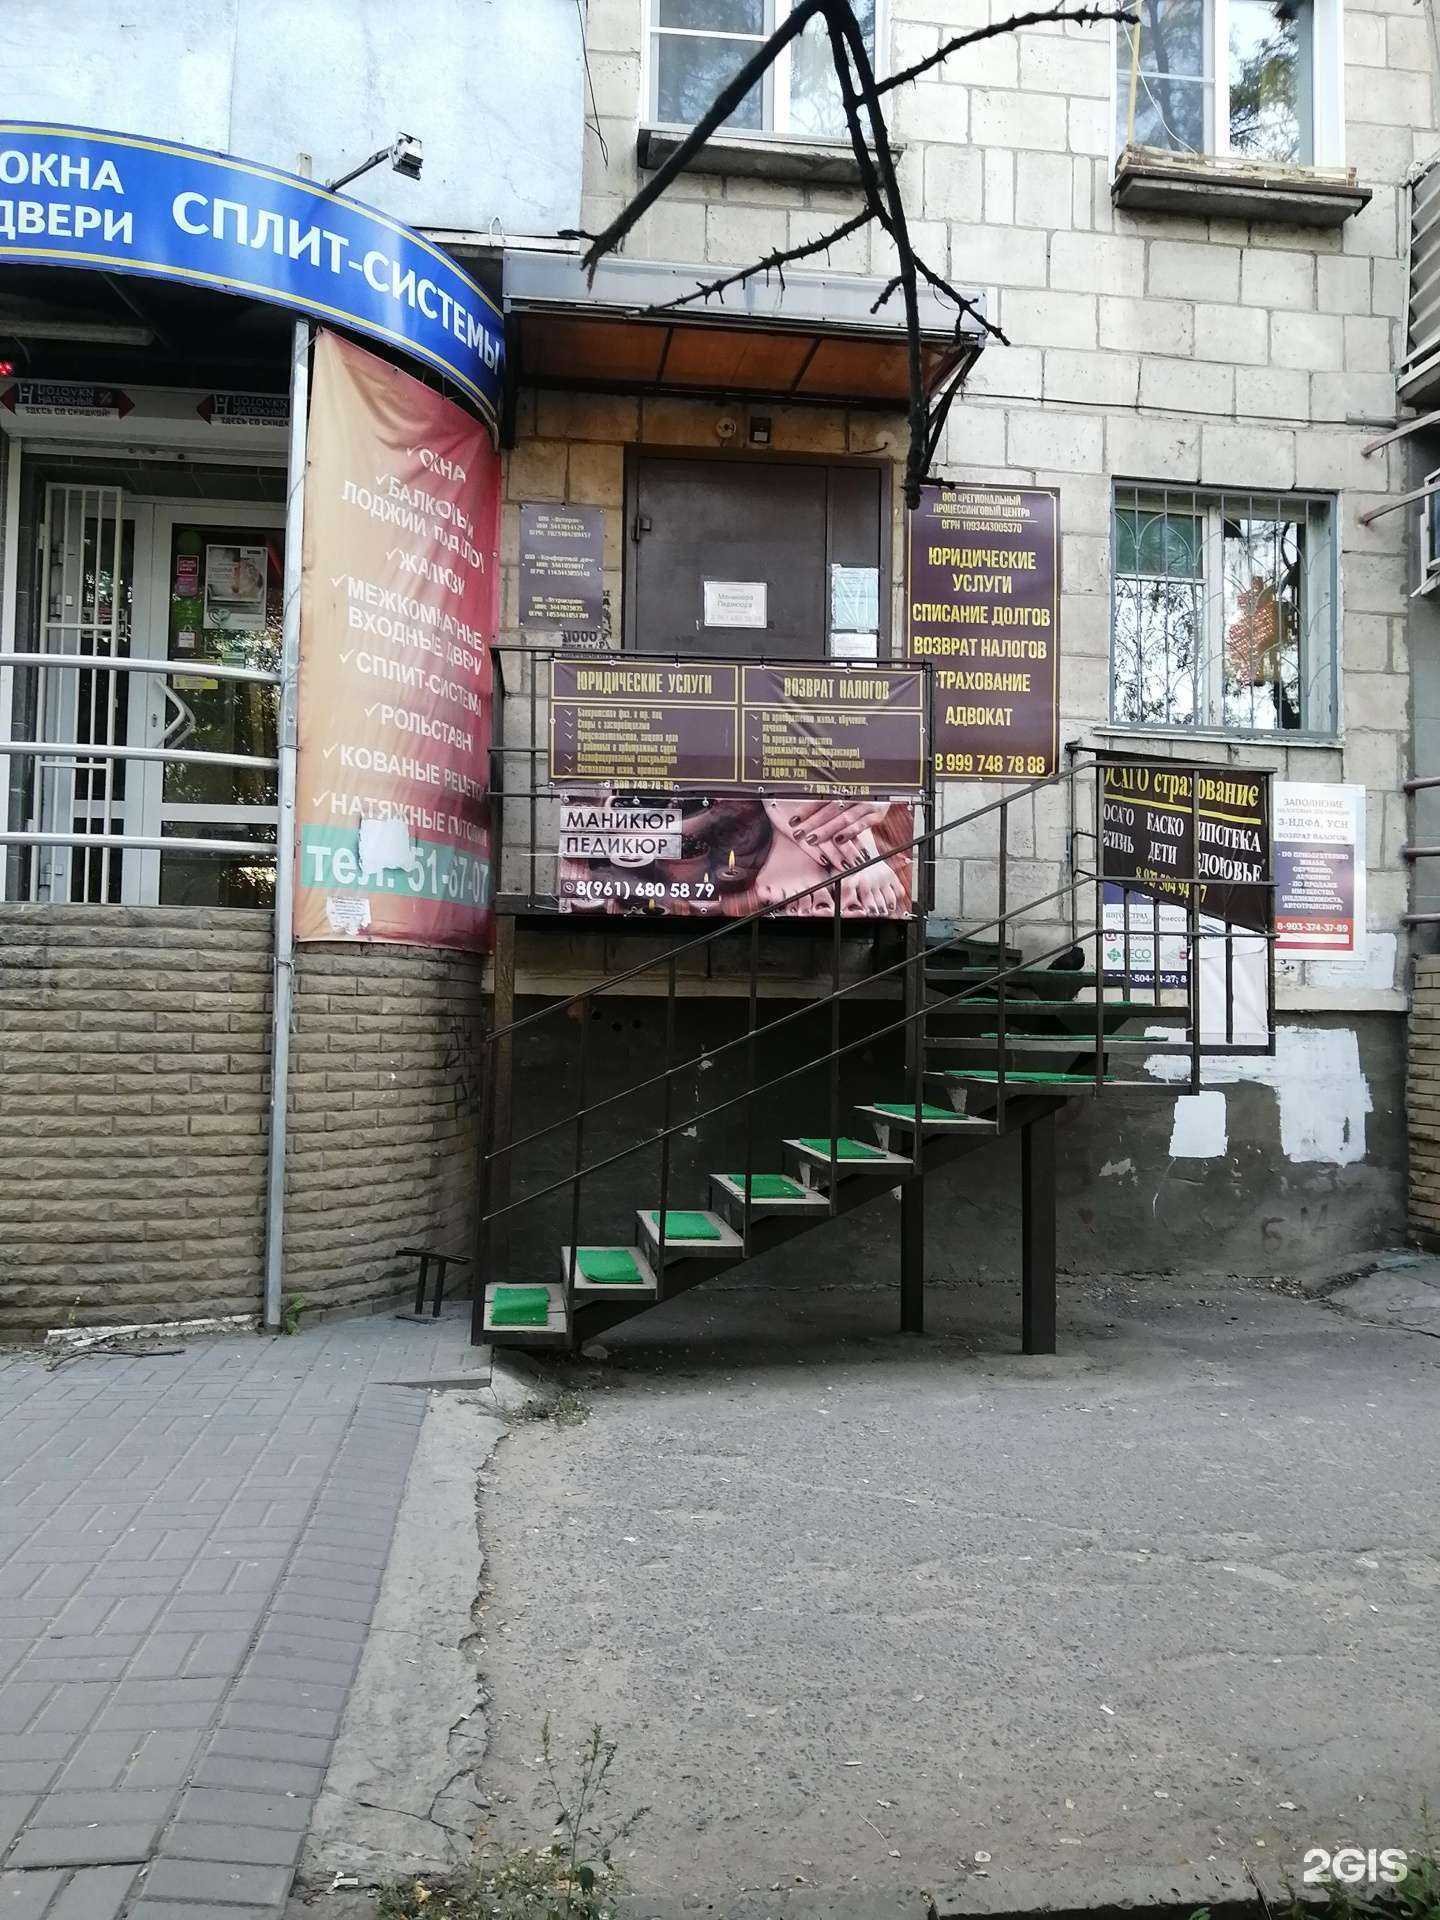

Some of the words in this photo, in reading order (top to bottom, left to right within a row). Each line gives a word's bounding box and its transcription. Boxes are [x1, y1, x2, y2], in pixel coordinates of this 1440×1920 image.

[0, 150, 124, 194] ОКНА
[0, 200, 133, 244] ДВЕРИ
[172, 191, 500, 375] СПЛИТ-СИСТЕМЫ
[420, 448, 466, 483] ОКНА
[342, 480, 426, 537] ЛОДЖИИ
[942, 492, 956, 502] ООО
[933, 503, 1001, 516] ПРОЦЕССИНГОВЫЙ
[942, 519, 960, 530] ОГРН
[928, 547, 1036, 570] ЮРИДИЧЕСКИЕ
[400, 550, 465, 597] ЖАЛЮЗИ
[953, 574, 1012, 594] УСЛУГИ
[912, 603, 988, 625] СПИСАНИЕ
[991, 606, 1050, 627] ДОЛГОВ
[914, 636, 977, 656] ВОЗВРАТ
[981, 638, 1047, 660] НАЛОГОВ
[577, 671, 663, 694] ЮРИДИЧЕСКИЕ
[669, 674, 712, 694] УСЛУГИ
[784, 677, 835, 699] ВОЗВРАТ
[839, 679, 890, 701] НАЛОГОВ
[936, 670, 1031, 693] ТРАХОВАНИЕ
[945, 706, 1012, 727] АДВОКАТ
[340, 744, 440, 785] КОВАНЫЕ
[946, 753, 973, 772] 999
[977, 754, 1002, 773] 748
[1007, 755, 1024, 774] 78
[1027, 756, 1045, 774] 88
[1154, 772, 1259, 807] страование
[331, 792, 445, 833] НАТЯЖНЫЕ
[567, 812, 675, 830] МАНИКЮР
[1327, 819, 1348, 829] УСН
[1147, 812, 1184, 837] КАСКО
[1199, 821, 1261, 853] ИПОТЕКА
[565, 838, 668, 855] ПЕДИКЮР
[1148, 841, 1177, 865] ДЕТИ
[576, 880, 631, 898] 8(961)
[635, 882, 665, 898] 680
[669, 882, 691, 898] 58
[695, 883, 715, 899] 79
